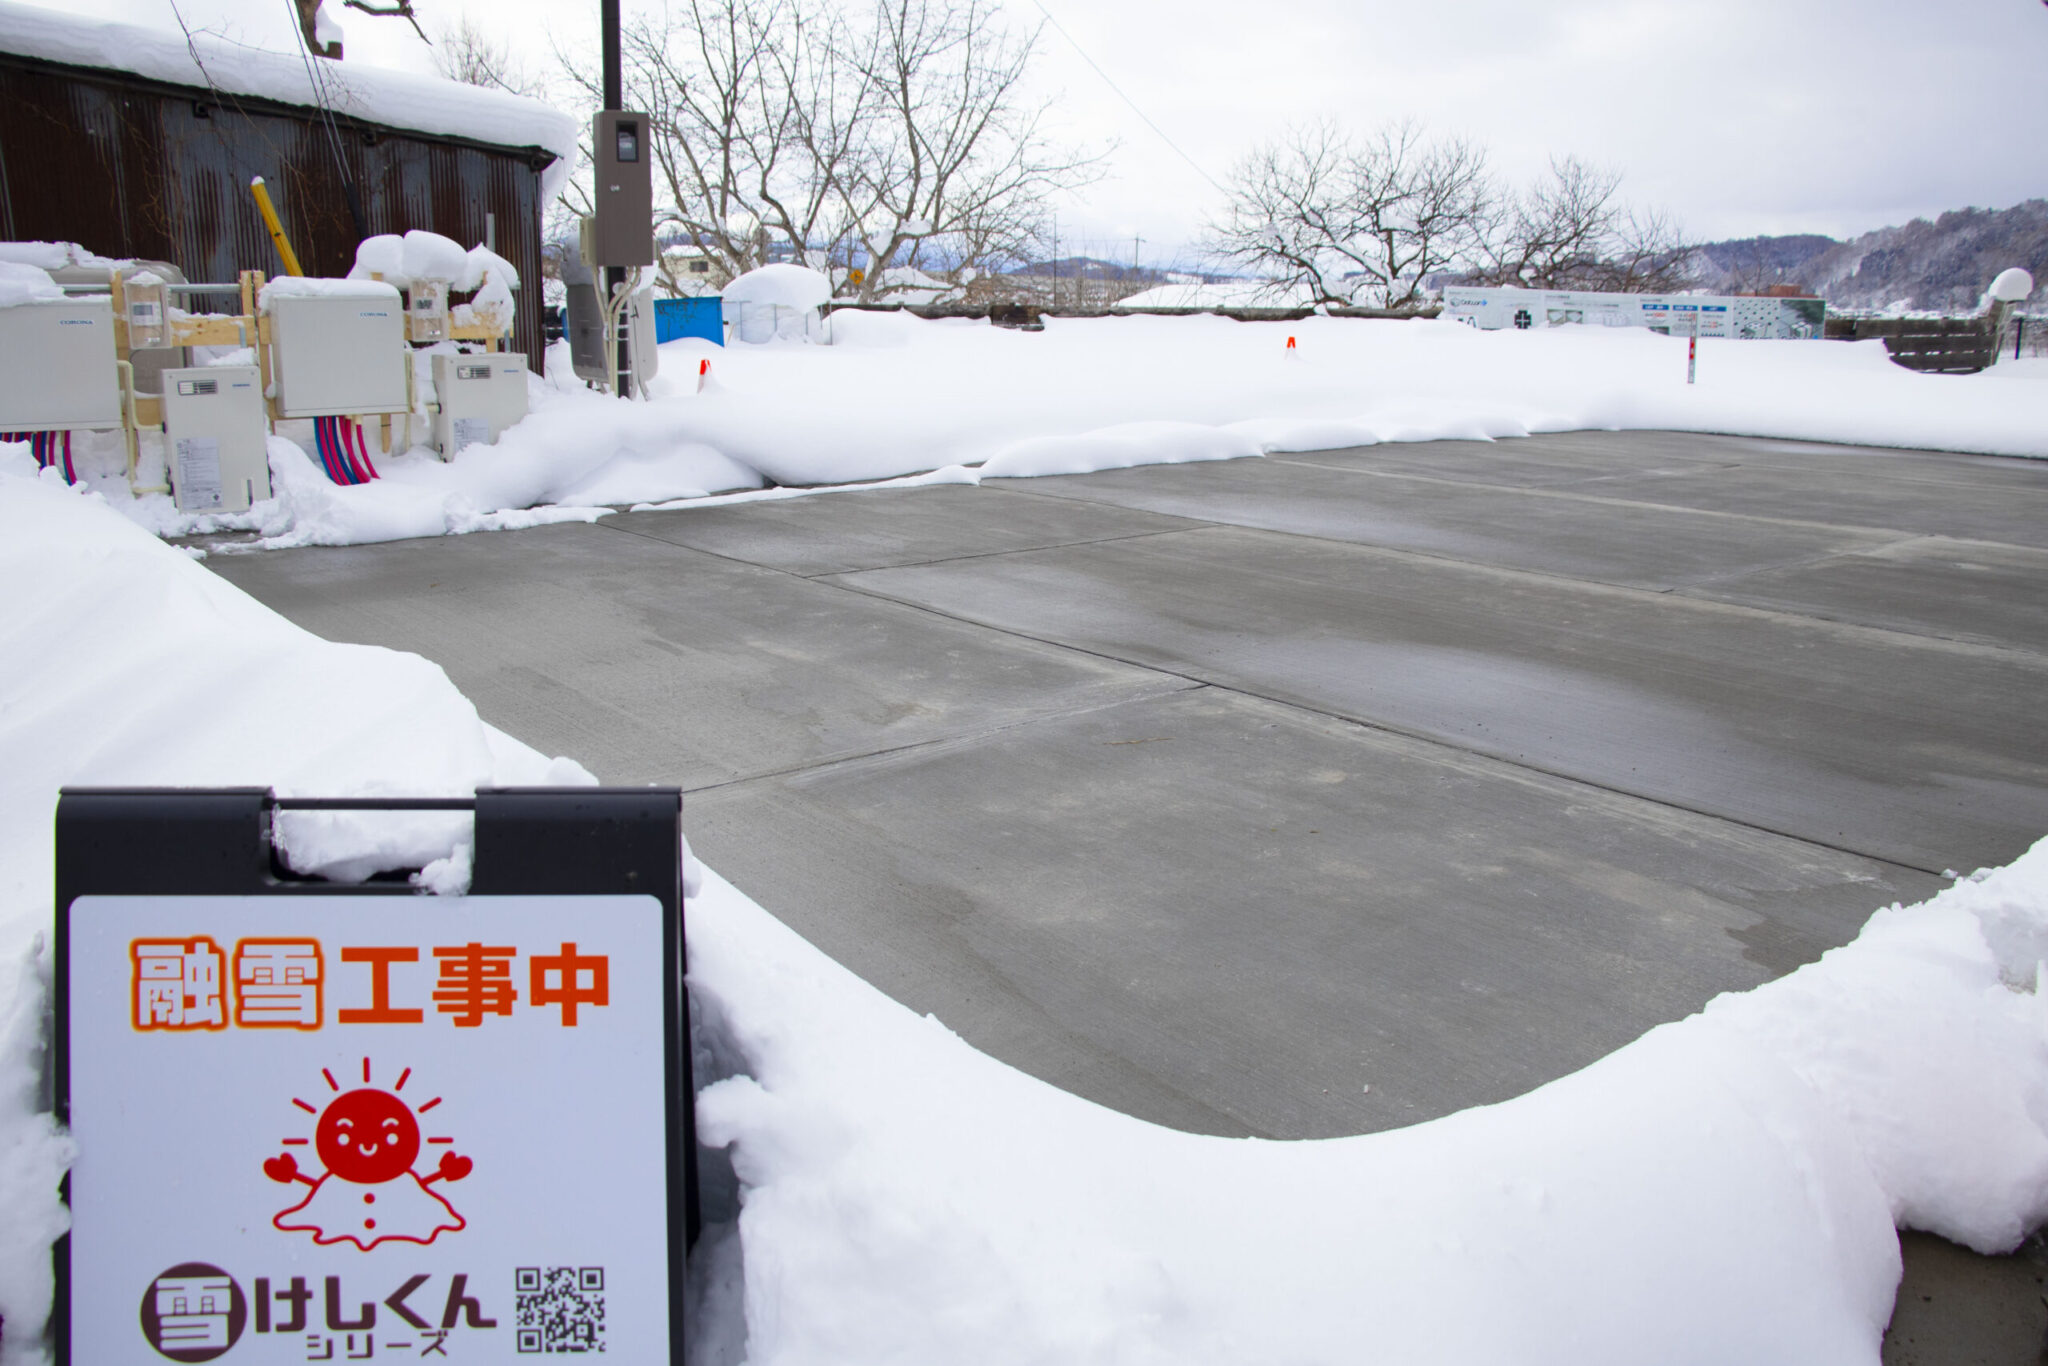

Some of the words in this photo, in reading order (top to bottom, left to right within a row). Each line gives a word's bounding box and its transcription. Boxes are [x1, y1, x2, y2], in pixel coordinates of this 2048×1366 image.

[130, 936, 609, 1032] 融雪工事中
[306, 1329, 449, 1361] シリーズ
